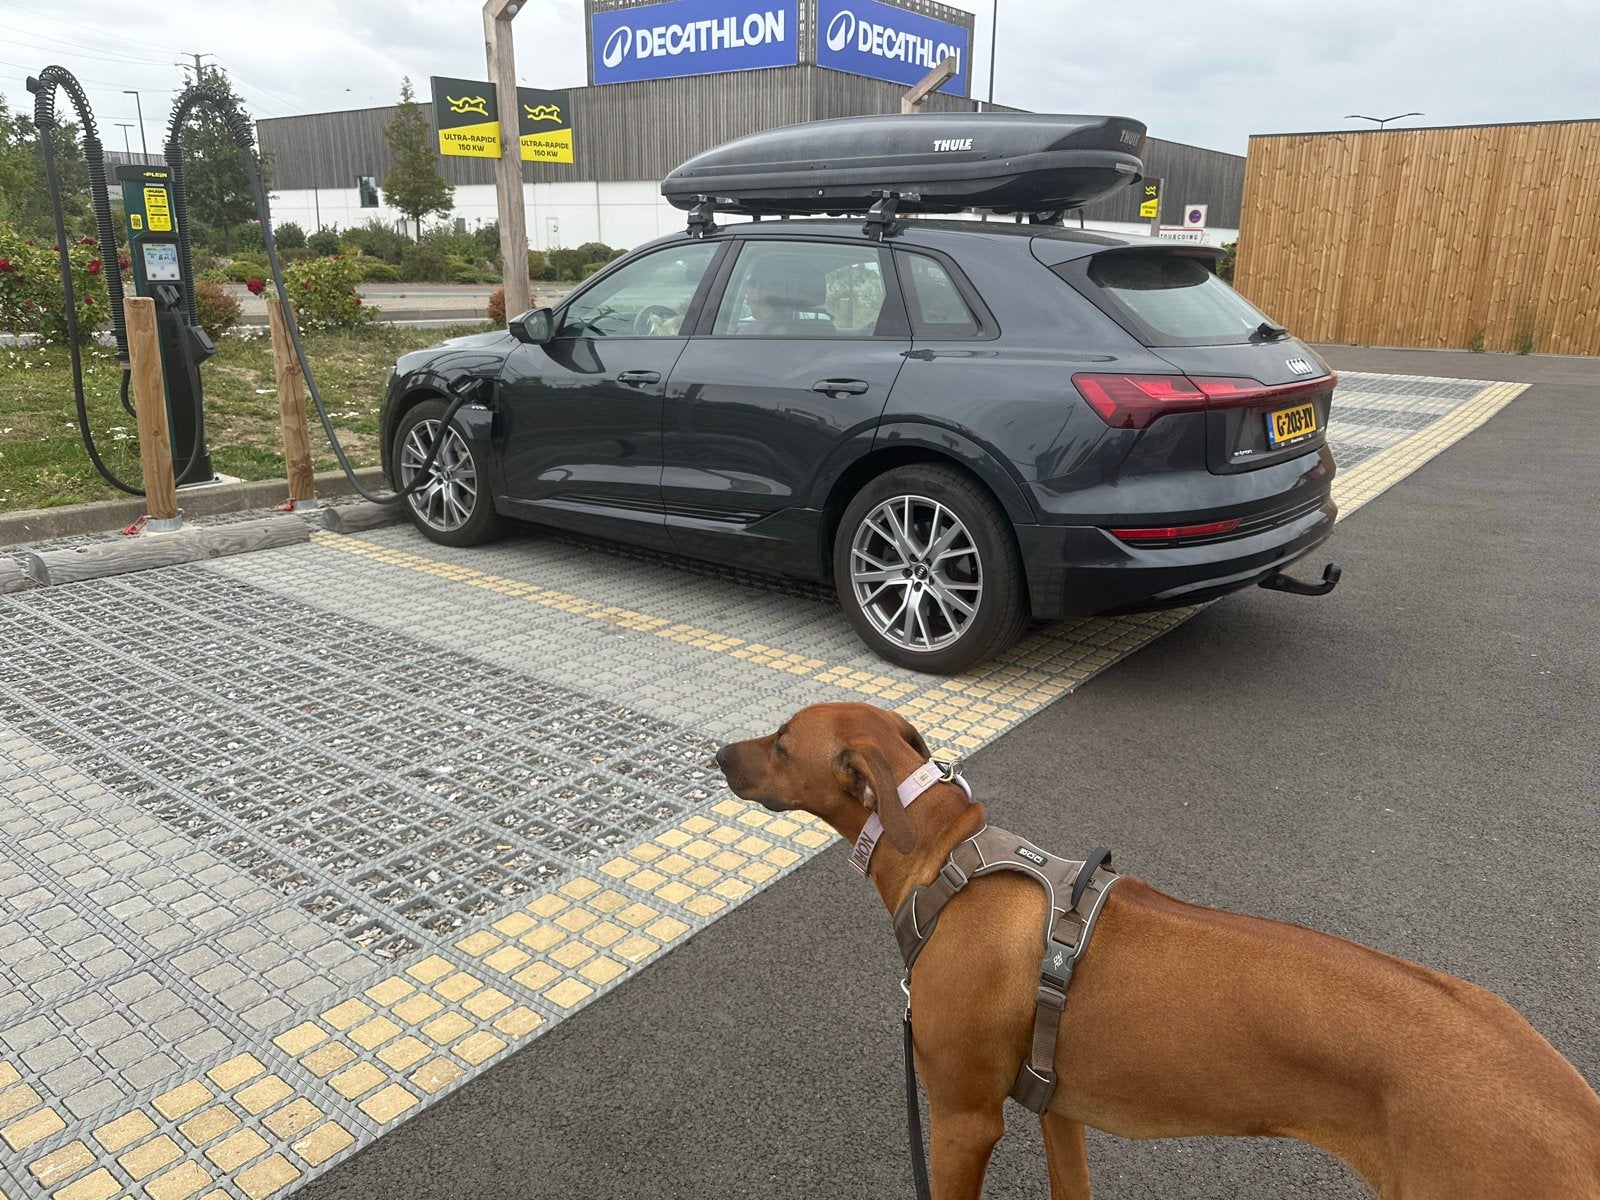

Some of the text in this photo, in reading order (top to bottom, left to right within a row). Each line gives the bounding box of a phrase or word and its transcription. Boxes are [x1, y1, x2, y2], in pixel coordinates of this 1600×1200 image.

[636, 9, 785, 60] DECATHLON
[858, 19, 961, 75] DECATHLON
[444, 134, 497, 143] ULTRA-RAPIDE
[521, 140, 569, 149] ULTRA-RAPIDE
[933, 138, 973, 152] THULE
[1160, 233, 1199, 241] TOURCOING
